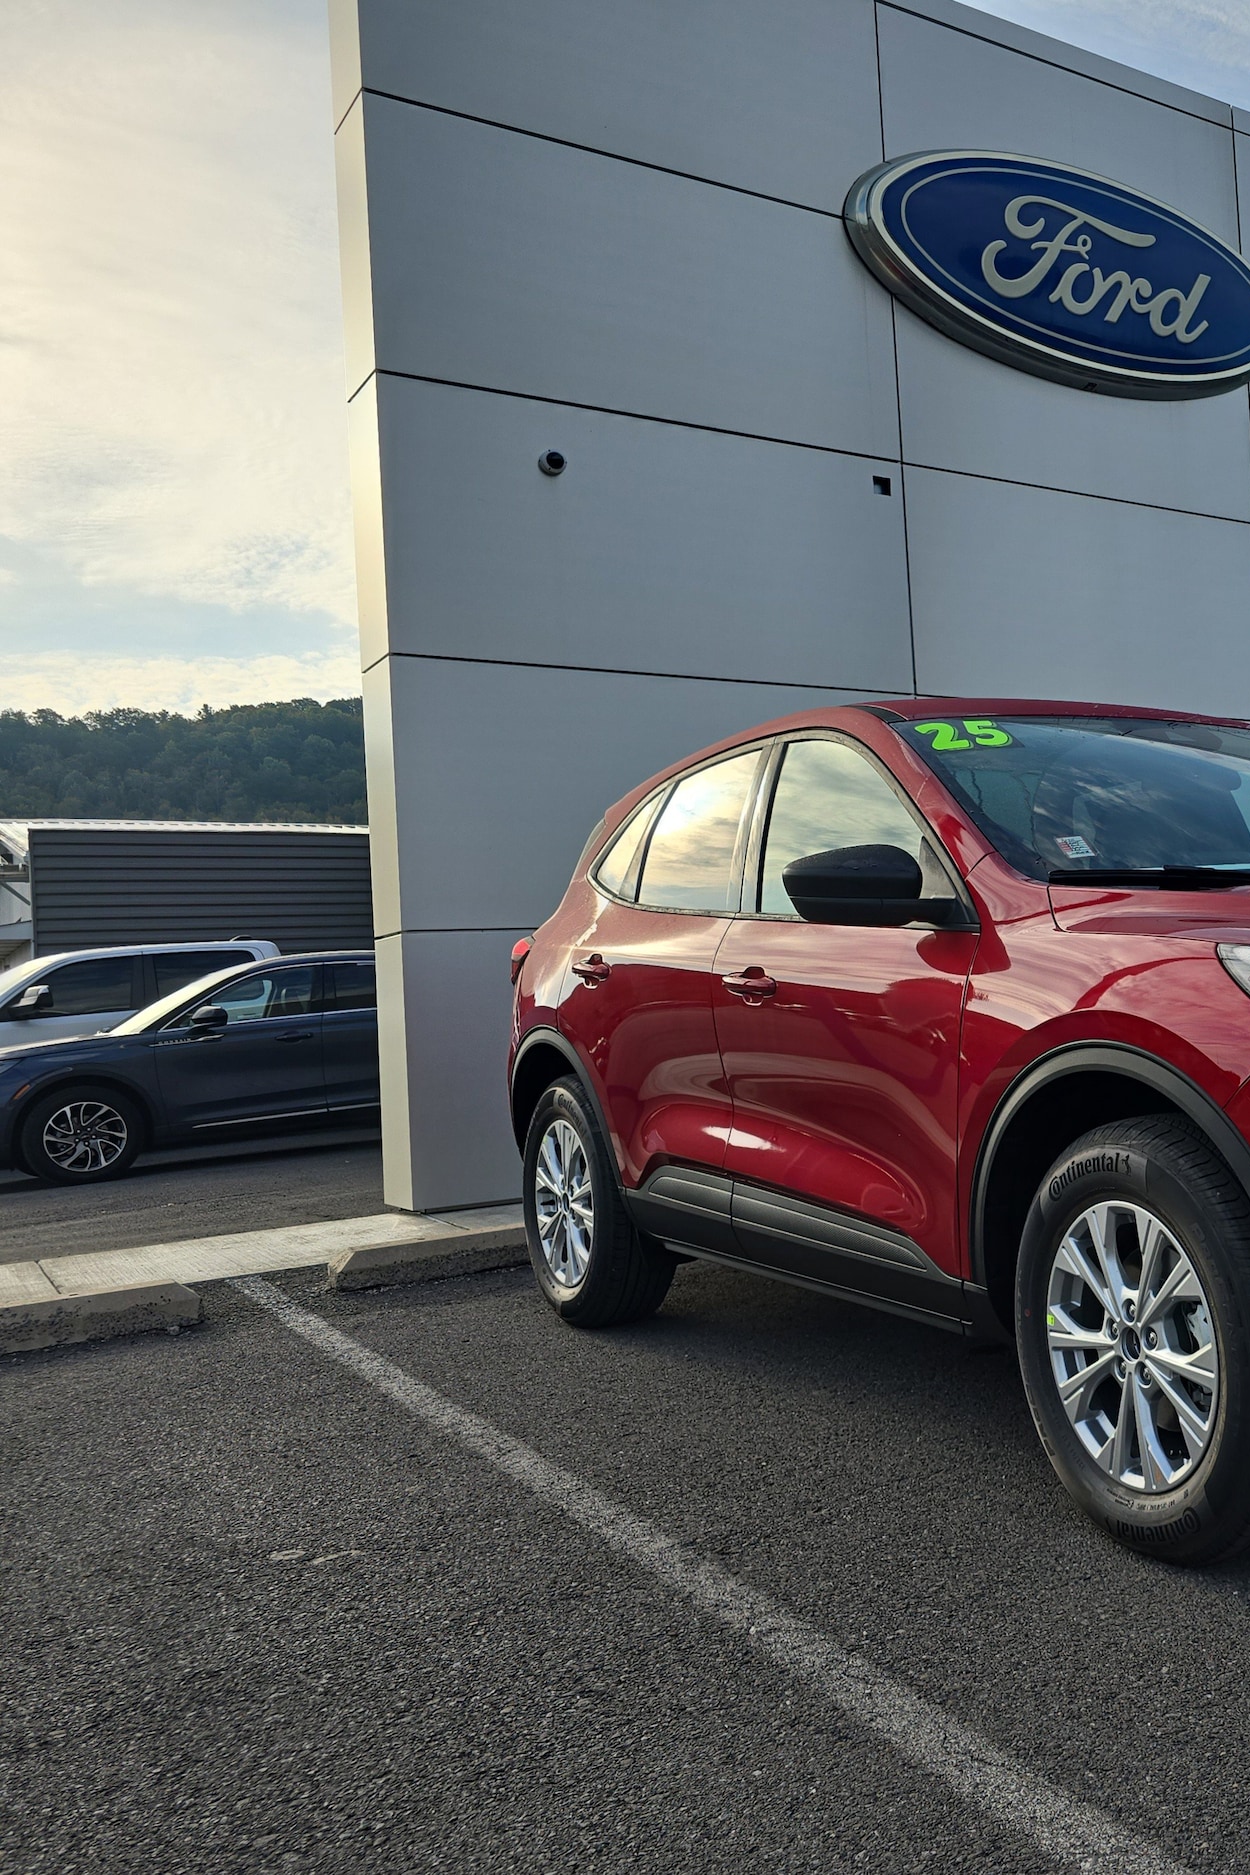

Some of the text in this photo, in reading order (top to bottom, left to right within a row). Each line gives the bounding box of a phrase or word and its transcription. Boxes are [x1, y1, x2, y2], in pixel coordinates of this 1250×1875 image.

[981, 195, 1211, 344] Ford
[914, 720, 1012, 751] 25
[1049, 1152, 1120, 1201] Continental
